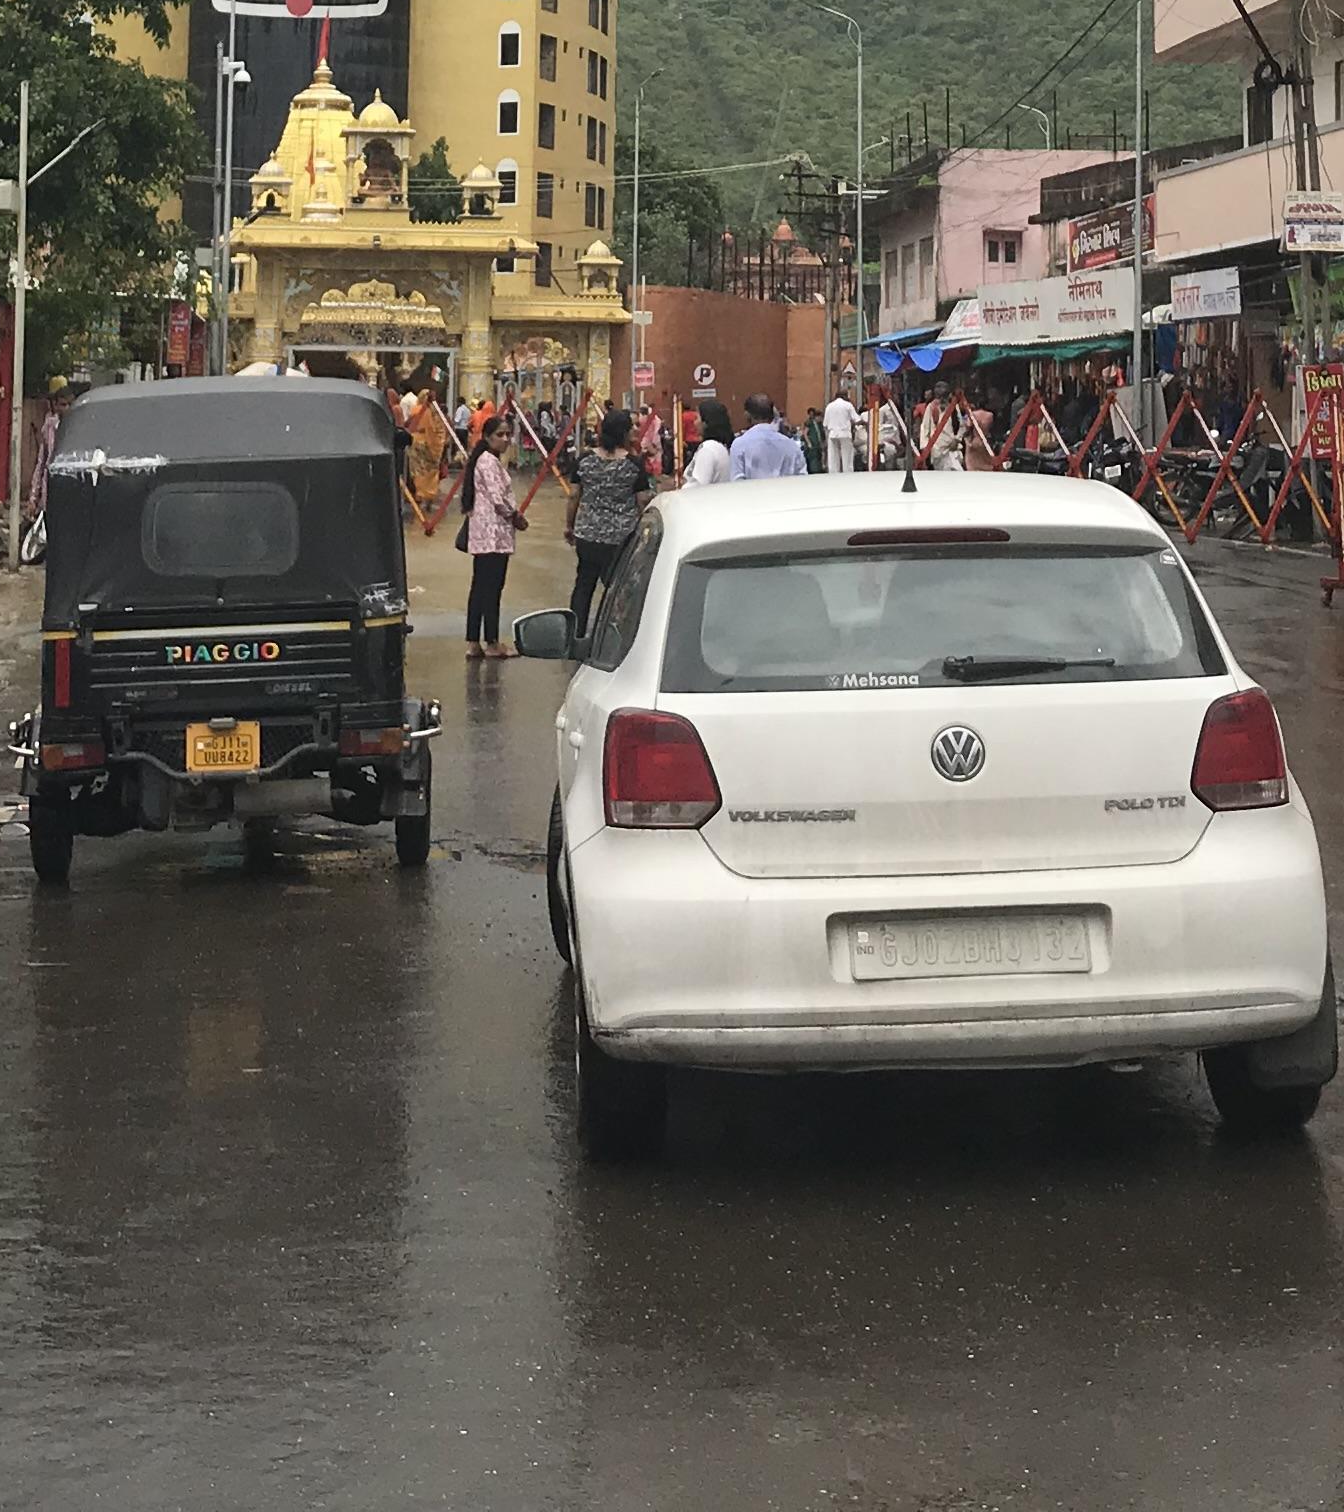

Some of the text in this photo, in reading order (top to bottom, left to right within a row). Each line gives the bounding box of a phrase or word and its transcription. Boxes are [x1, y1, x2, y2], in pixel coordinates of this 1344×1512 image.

[1067, 275, 1103, 303] नेमिनाथ
[164, 641, 281, 664] PIAGGIO
[842, 671, 920, 687] Mehsana
[1104, 794, 1186, 811] POLO TDI
[728, 809, 857, 823] VOLKSWAGEN
